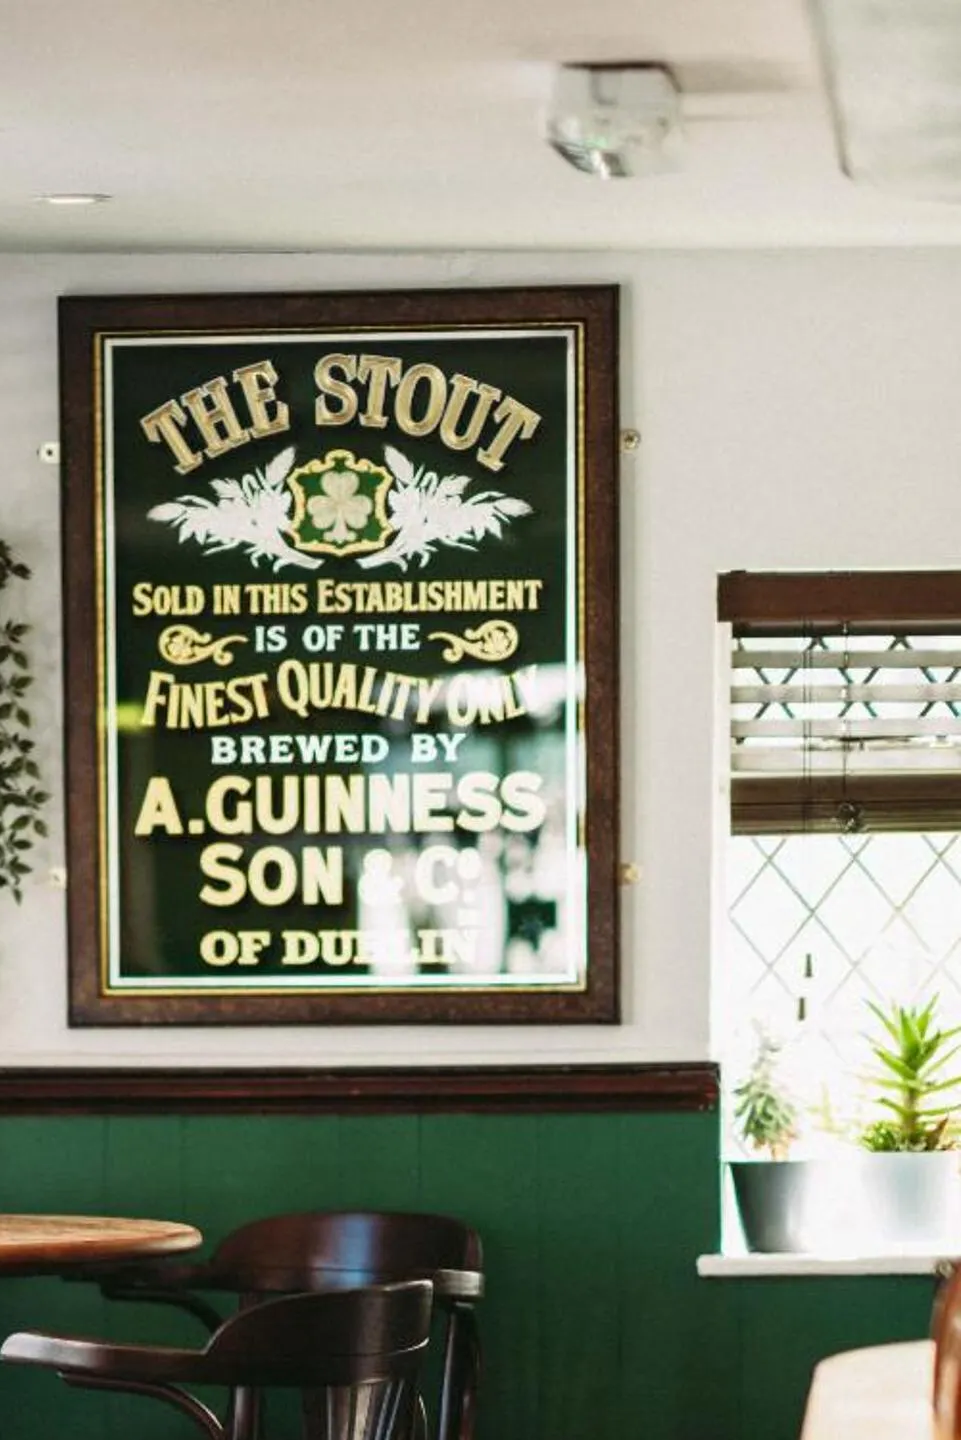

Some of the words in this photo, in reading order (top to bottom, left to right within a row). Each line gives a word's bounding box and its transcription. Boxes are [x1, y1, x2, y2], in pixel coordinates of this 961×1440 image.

[141, 360, 290, 475] THE
[314, 353, 542, 472] STOUT
[132, 582, 204, 617] SOLD
[213, 584, 239, 615] IN
[245, 582, 308, 614] THIS
[317, 578, 543, 613] ESTABLISHMENT
[255, 626, 287, 652] IS
[302, 625, 344, 651] OF
[353, 623, 420, 650] THE
[142, 670, 269, 729] FINEST
[277, 659, 443, 725] QUALITY
[211, 734, 389, 765] BREWED
[410, 733, 466, 763] BY
[199, 843, 344, 906] SON
[200, 930, 271, 966] OF
[281, 929, 480, 965] DUIN
